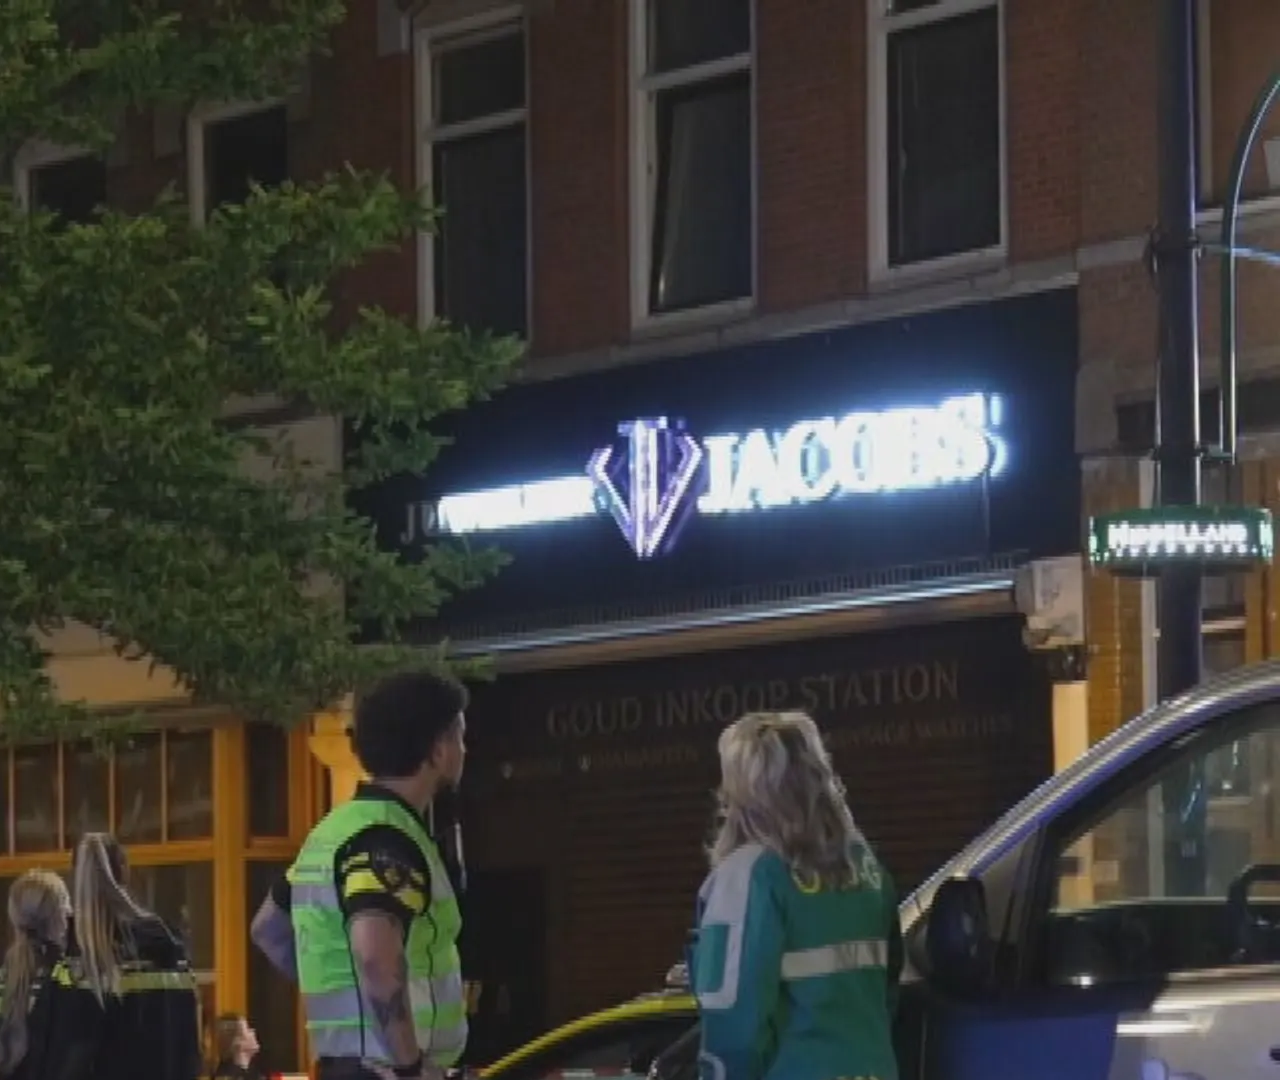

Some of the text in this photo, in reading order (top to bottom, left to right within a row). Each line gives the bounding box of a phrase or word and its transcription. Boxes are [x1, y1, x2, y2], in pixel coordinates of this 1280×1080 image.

[697, 393, 1005, 512] JACOBS
[547, 659, 962, 738] GOUD INKOOP STATION
